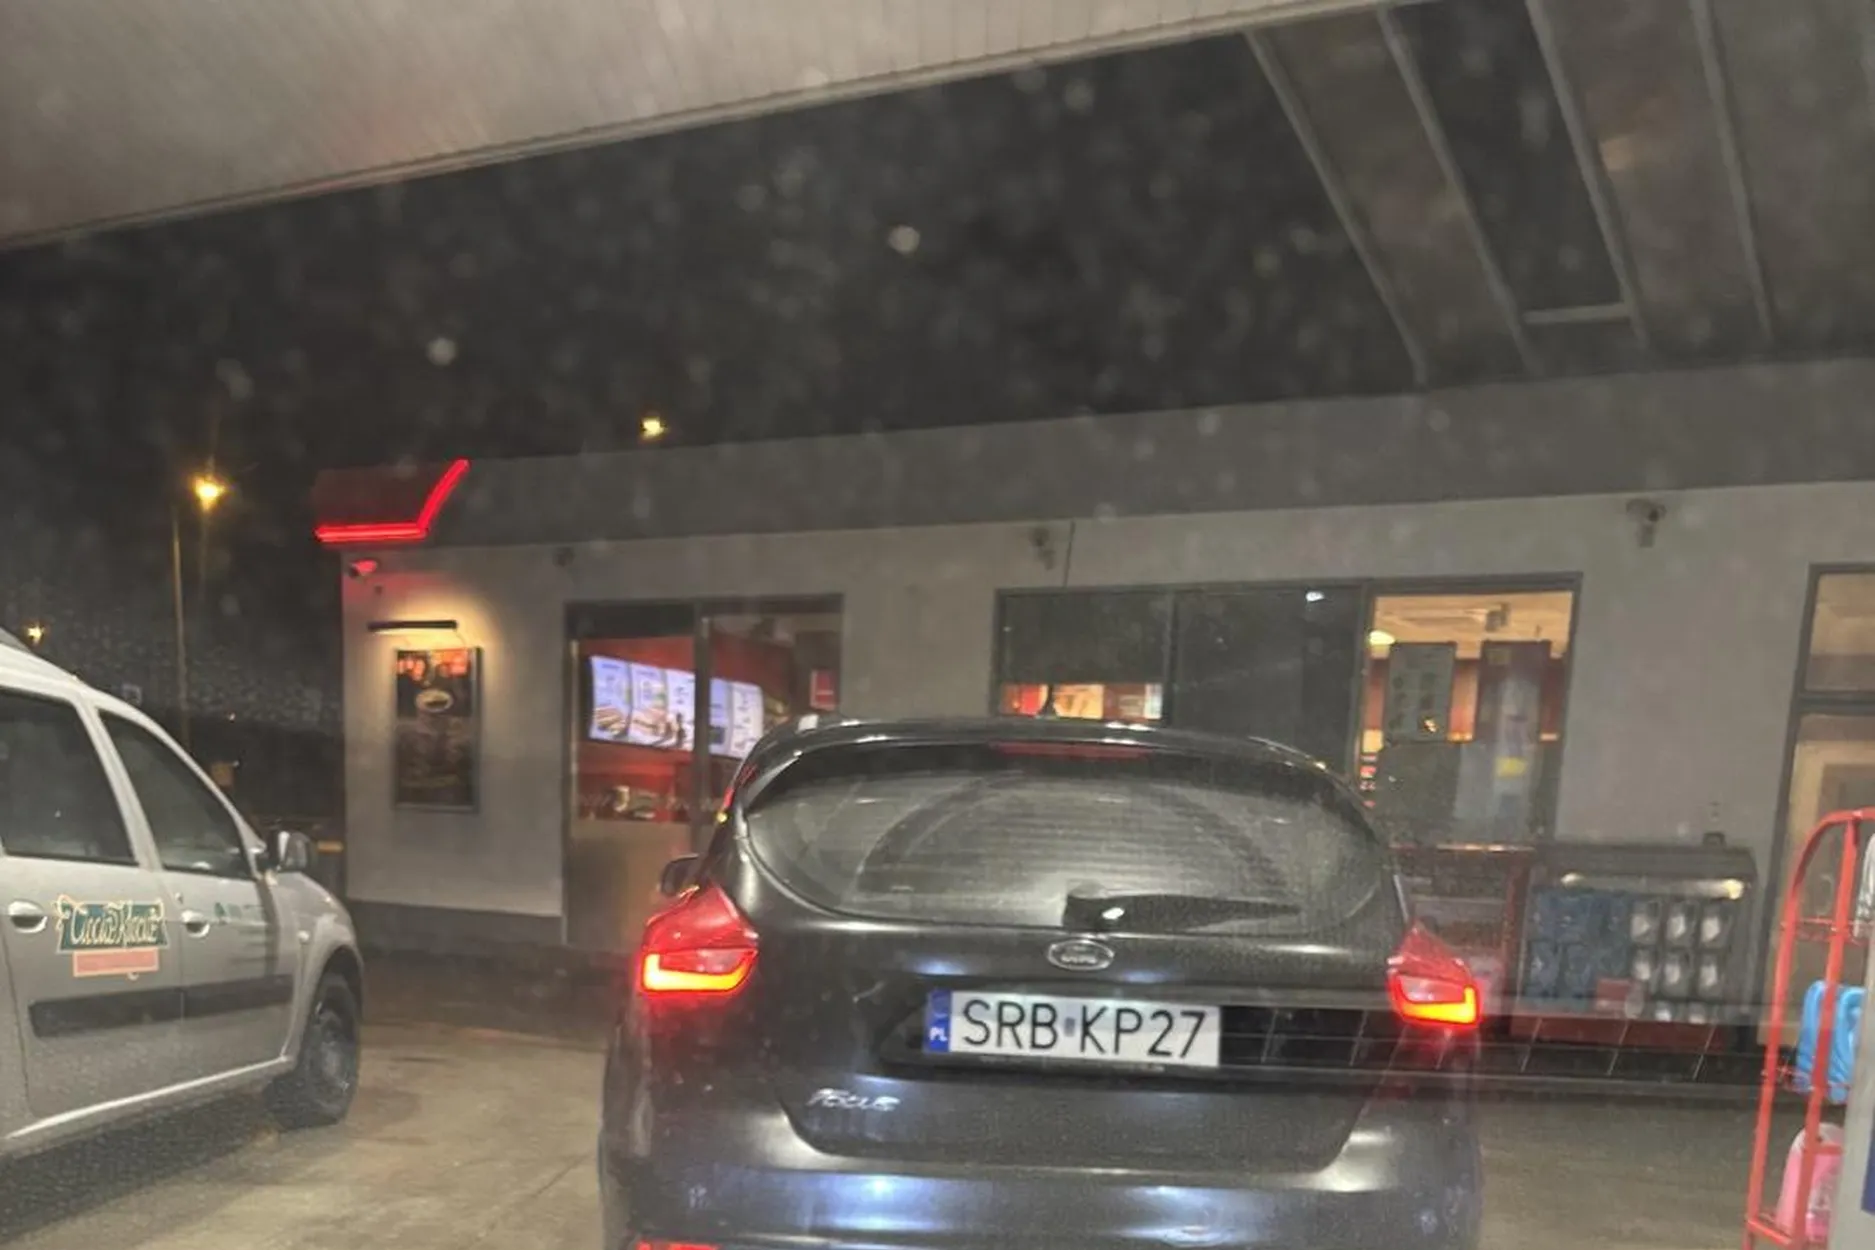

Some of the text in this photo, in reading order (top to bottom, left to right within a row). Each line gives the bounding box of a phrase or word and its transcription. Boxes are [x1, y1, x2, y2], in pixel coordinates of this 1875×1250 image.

[930, 1026, 948, 1042] PL
[962, 999, 1207, 1059] SRB KP27
